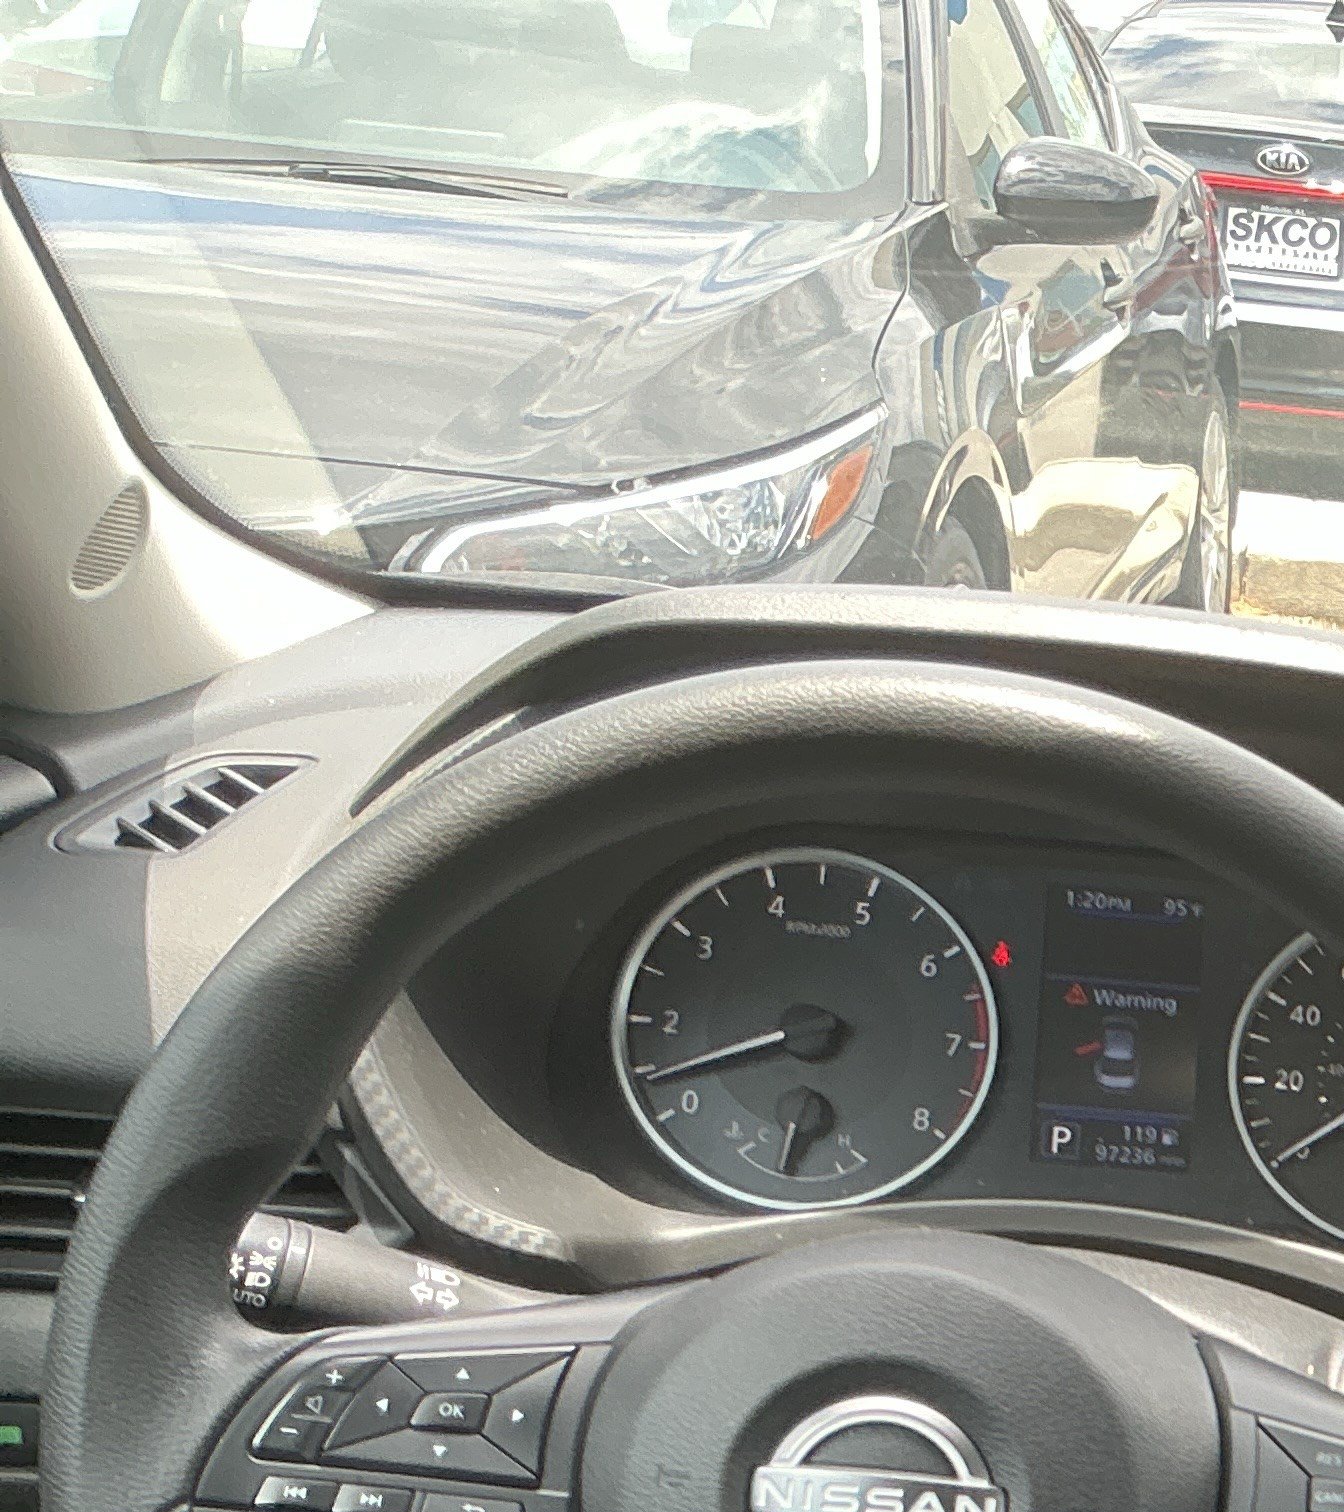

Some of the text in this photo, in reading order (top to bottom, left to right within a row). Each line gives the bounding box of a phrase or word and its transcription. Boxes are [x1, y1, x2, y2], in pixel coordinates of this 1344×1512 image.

[1265, 152, 1300, 170] KIA
[1229, 212, 1338, 250] SKCO
[769, 895, 785, 918] 4
[855, 901, 871, 925] 5
[697, 936, 713, 960] 3
[920, 955, 938, 977] 6
[1094, 988, 1178, 1016] Warning
[662, 1009, 679, 1034] 2
[1290, 1004, 1321, 1027] 40
[945, 1033, 962, 1057] 7
[1275, 1069, 1304, 1092] 20
[681, 1090, 699, 1113] 0
[913, 1107, 930, 1131] 8
[1052, 1125, 1072, 1154] P
[1122, 1125, 1157, 1146] 119
[439, 1402, 465, 1420] OK
